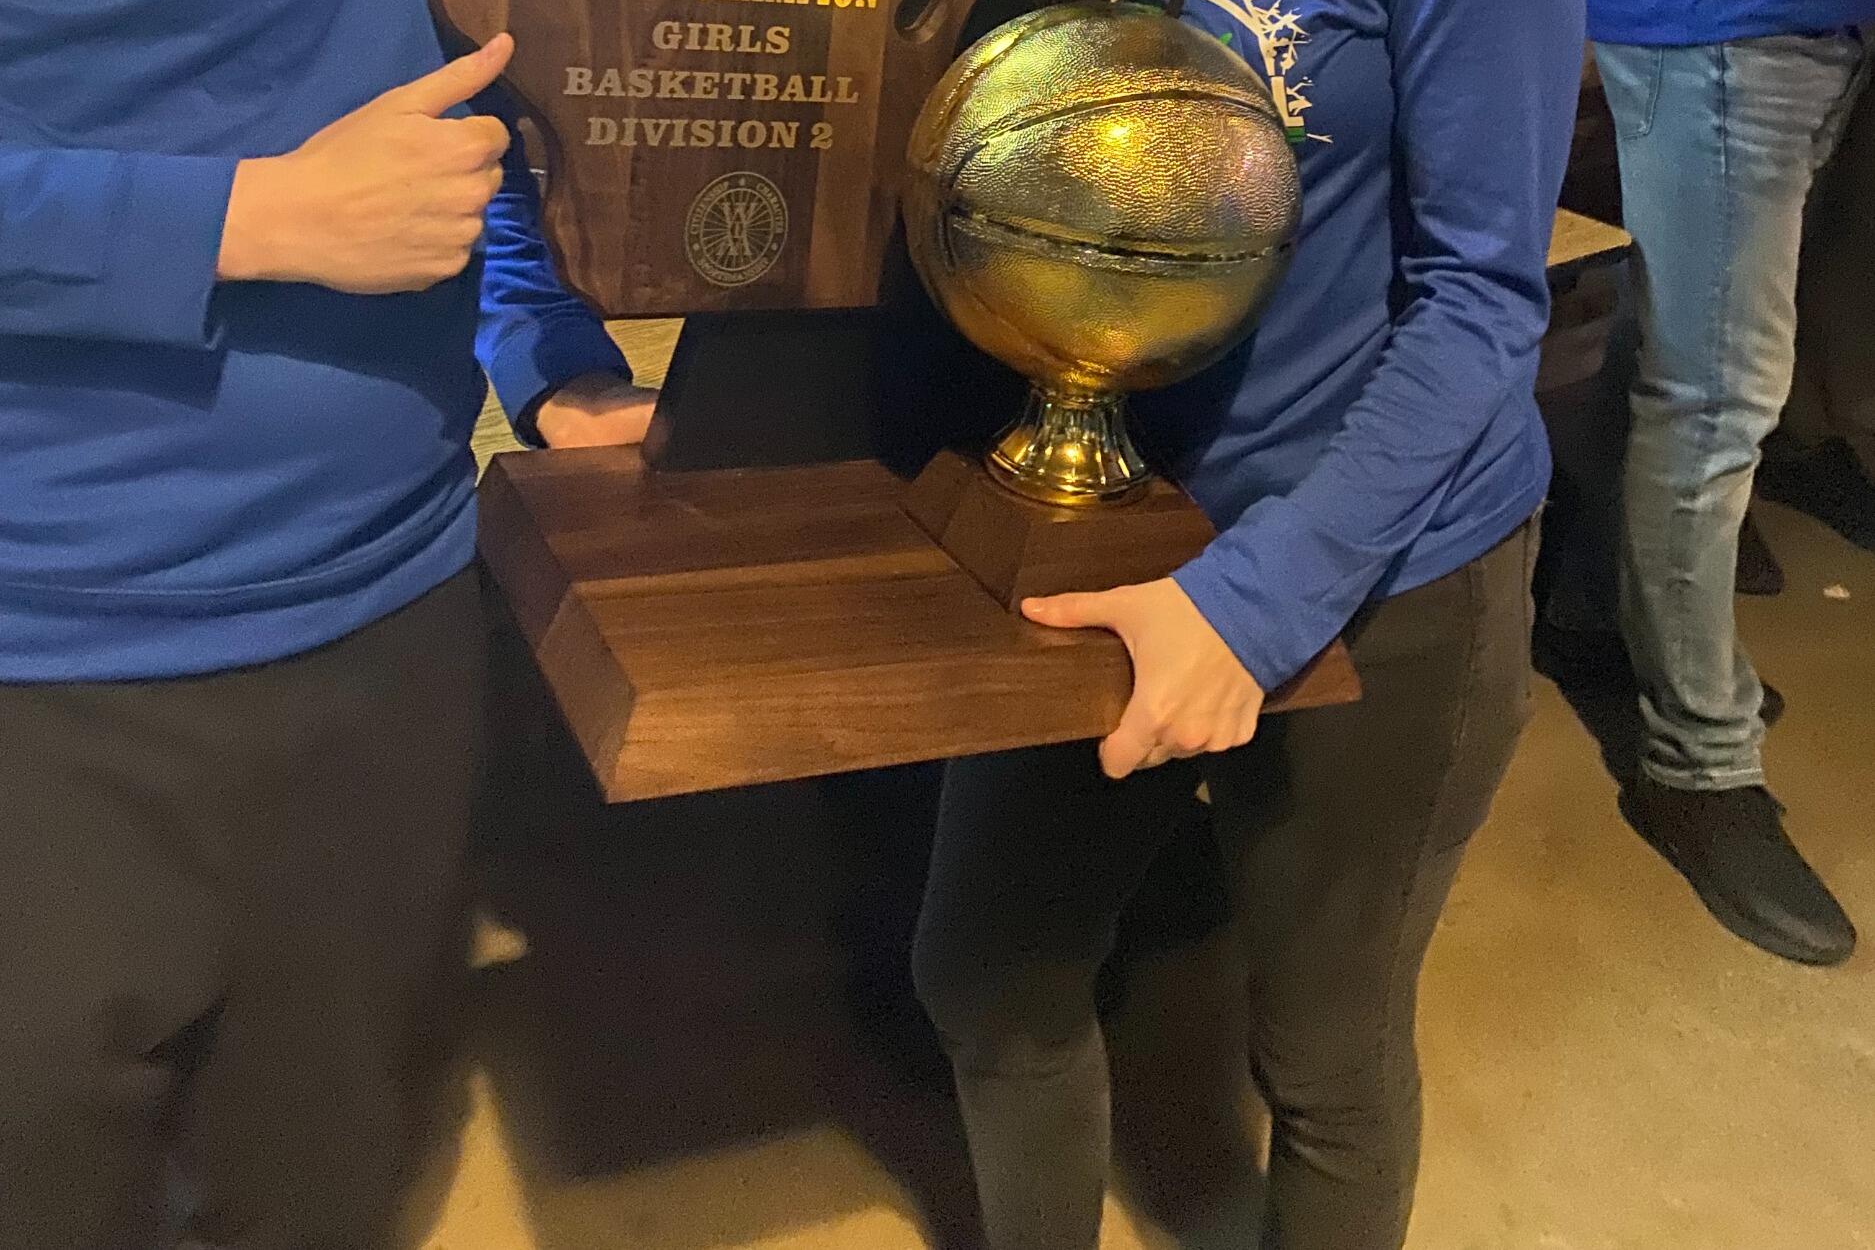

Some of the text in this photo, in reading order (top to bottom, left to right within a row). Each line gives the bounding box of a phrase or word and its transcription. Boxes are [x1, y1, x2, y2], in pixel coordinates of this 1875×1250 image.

[652, 21, 791, 54] GIRLS
[563, 67, 859, 103] BASKETBALL
[585, 117, 834, 149] DIVISION 2
